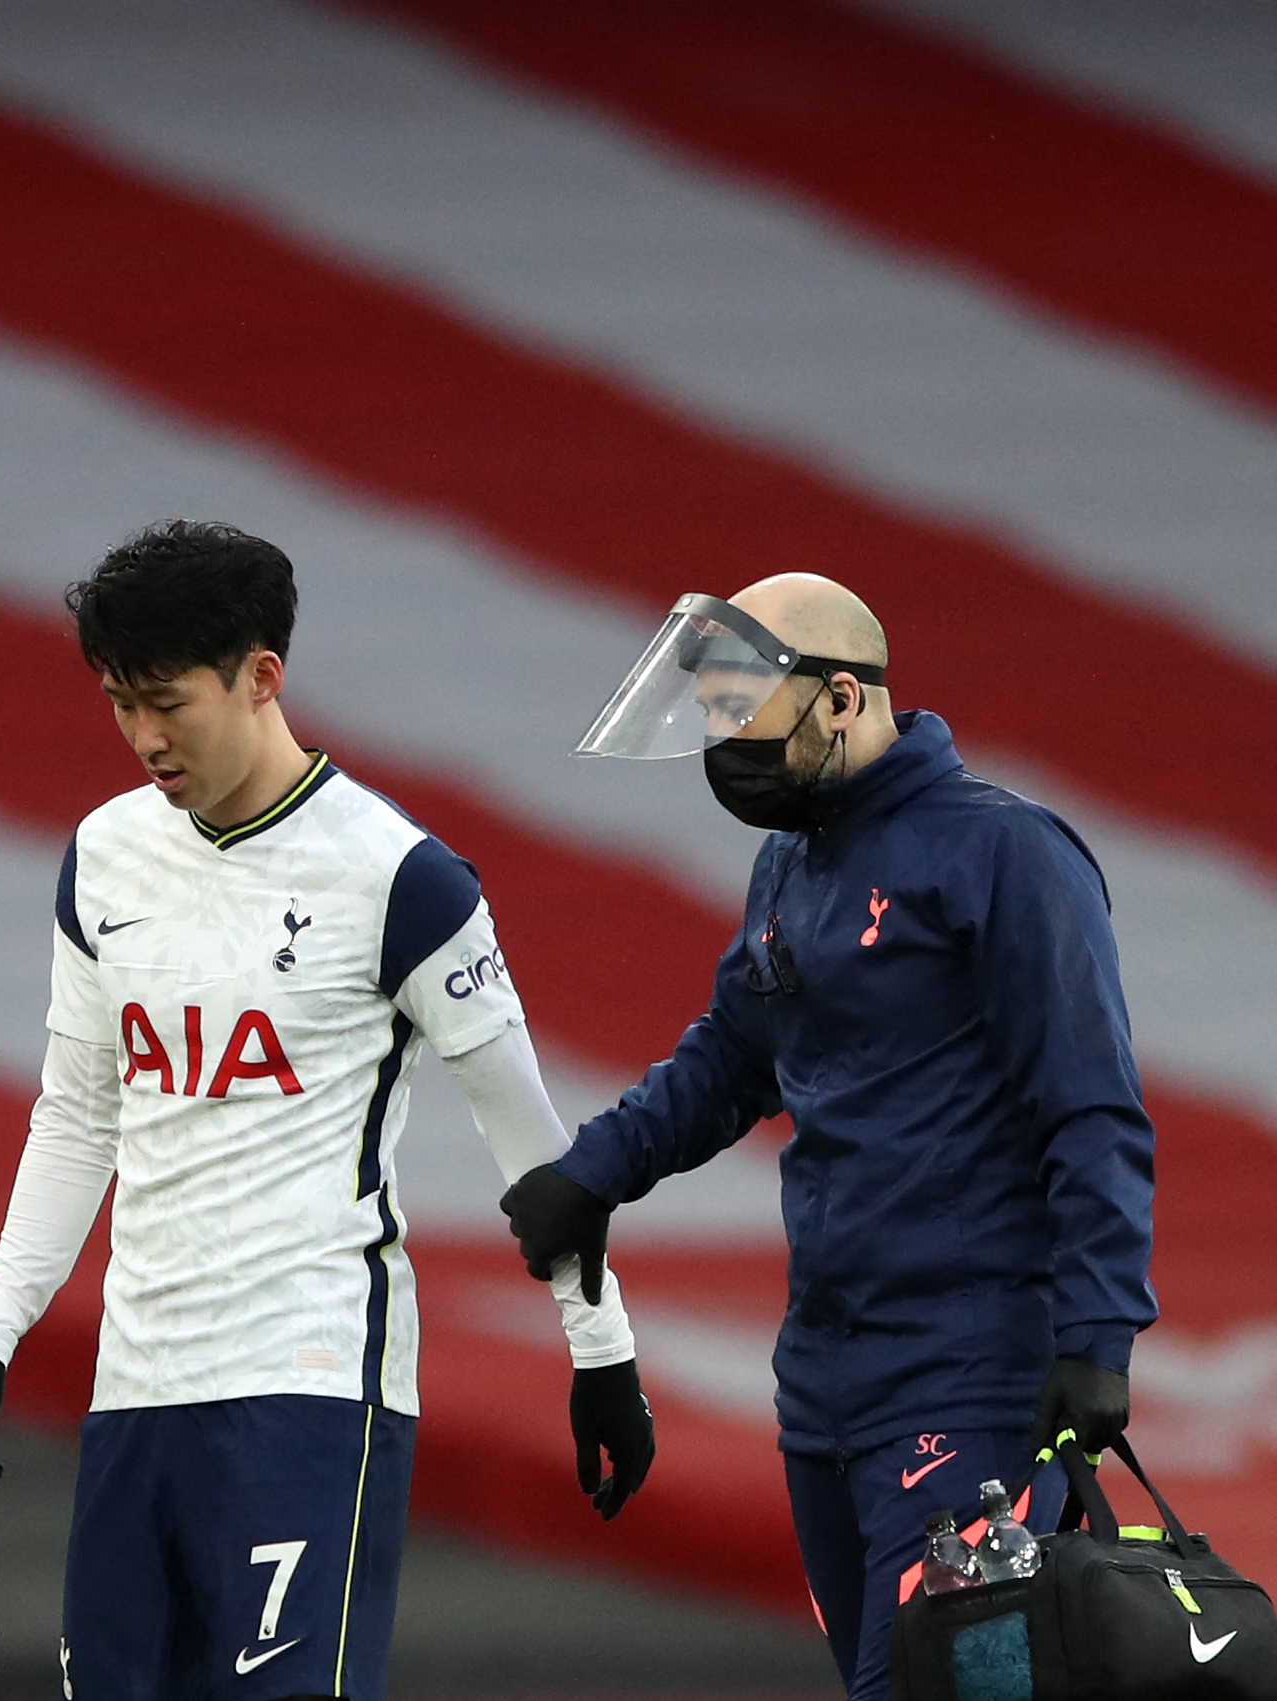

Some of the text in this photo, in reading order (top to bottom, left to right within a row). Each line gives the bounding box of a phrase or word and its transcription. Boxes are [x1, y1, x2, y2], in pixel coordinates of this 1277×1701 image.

[122, 1001, 305, 1098] AIA
[914, 1433, 947, 1456] SC
[250, 1540, 308, 1641] 7
